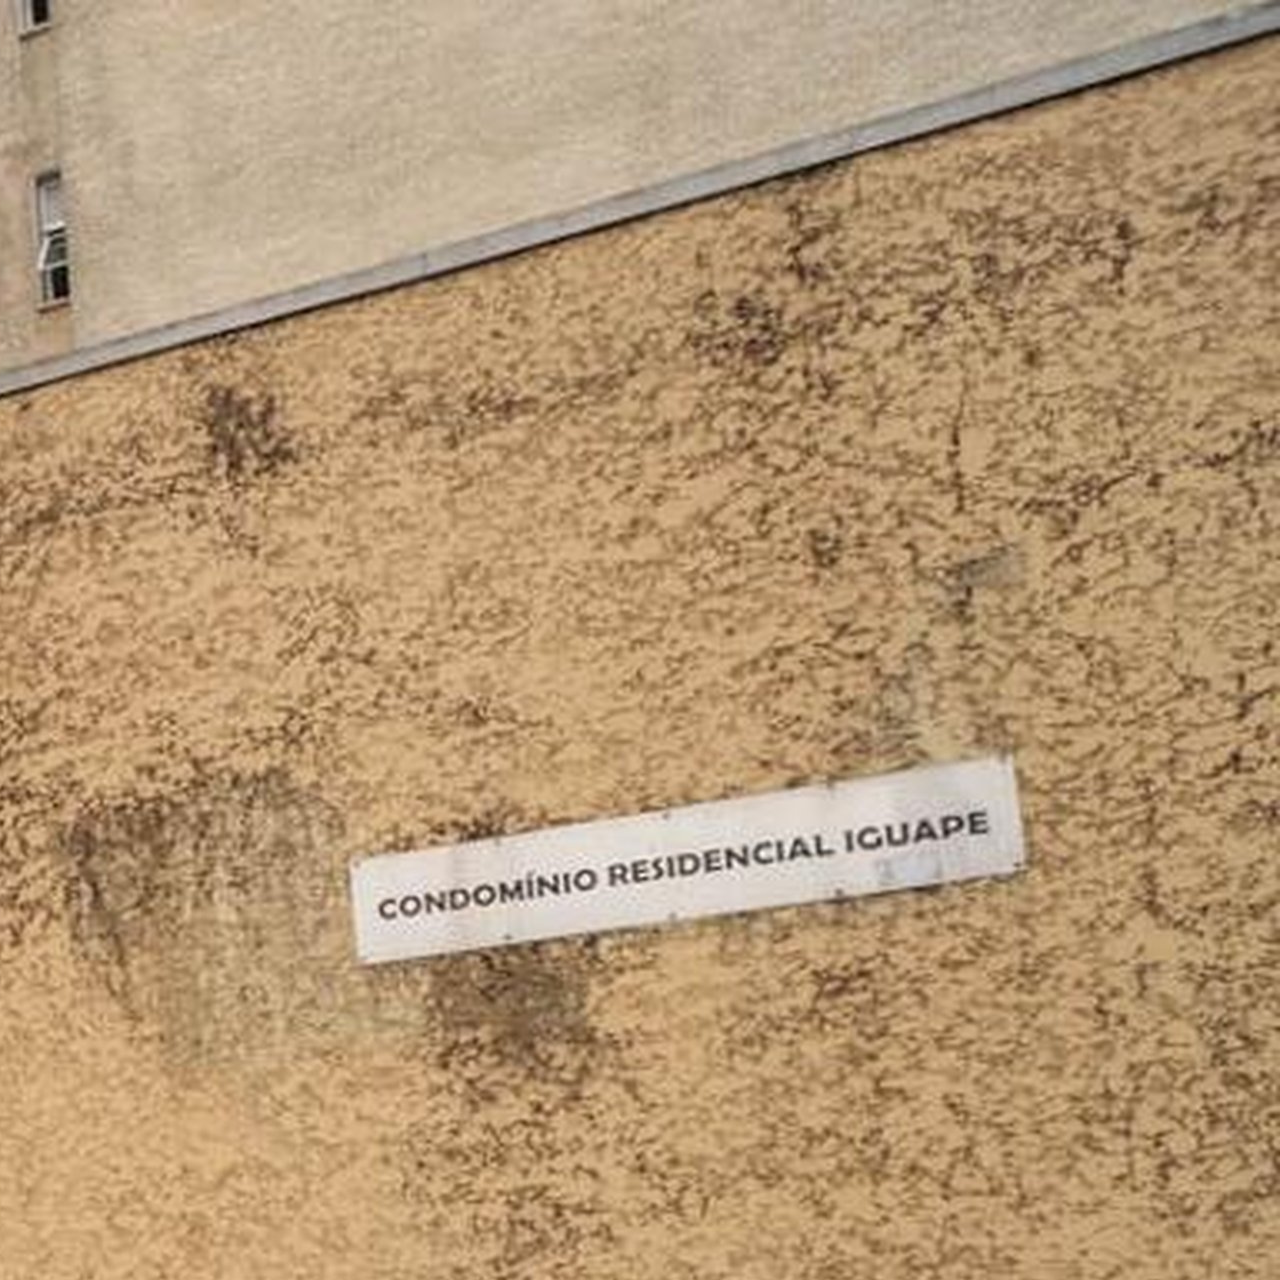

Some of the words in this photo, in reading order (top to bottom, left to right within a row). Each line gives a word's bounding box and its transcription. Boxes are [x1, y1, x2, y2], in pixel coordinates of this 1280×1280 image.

[378, 868, 598, 920] CONDOMÍNIO
[607, 834, 836, 887] RESIDENCIAL
[844, 811, 989, 853] IGUAPE
